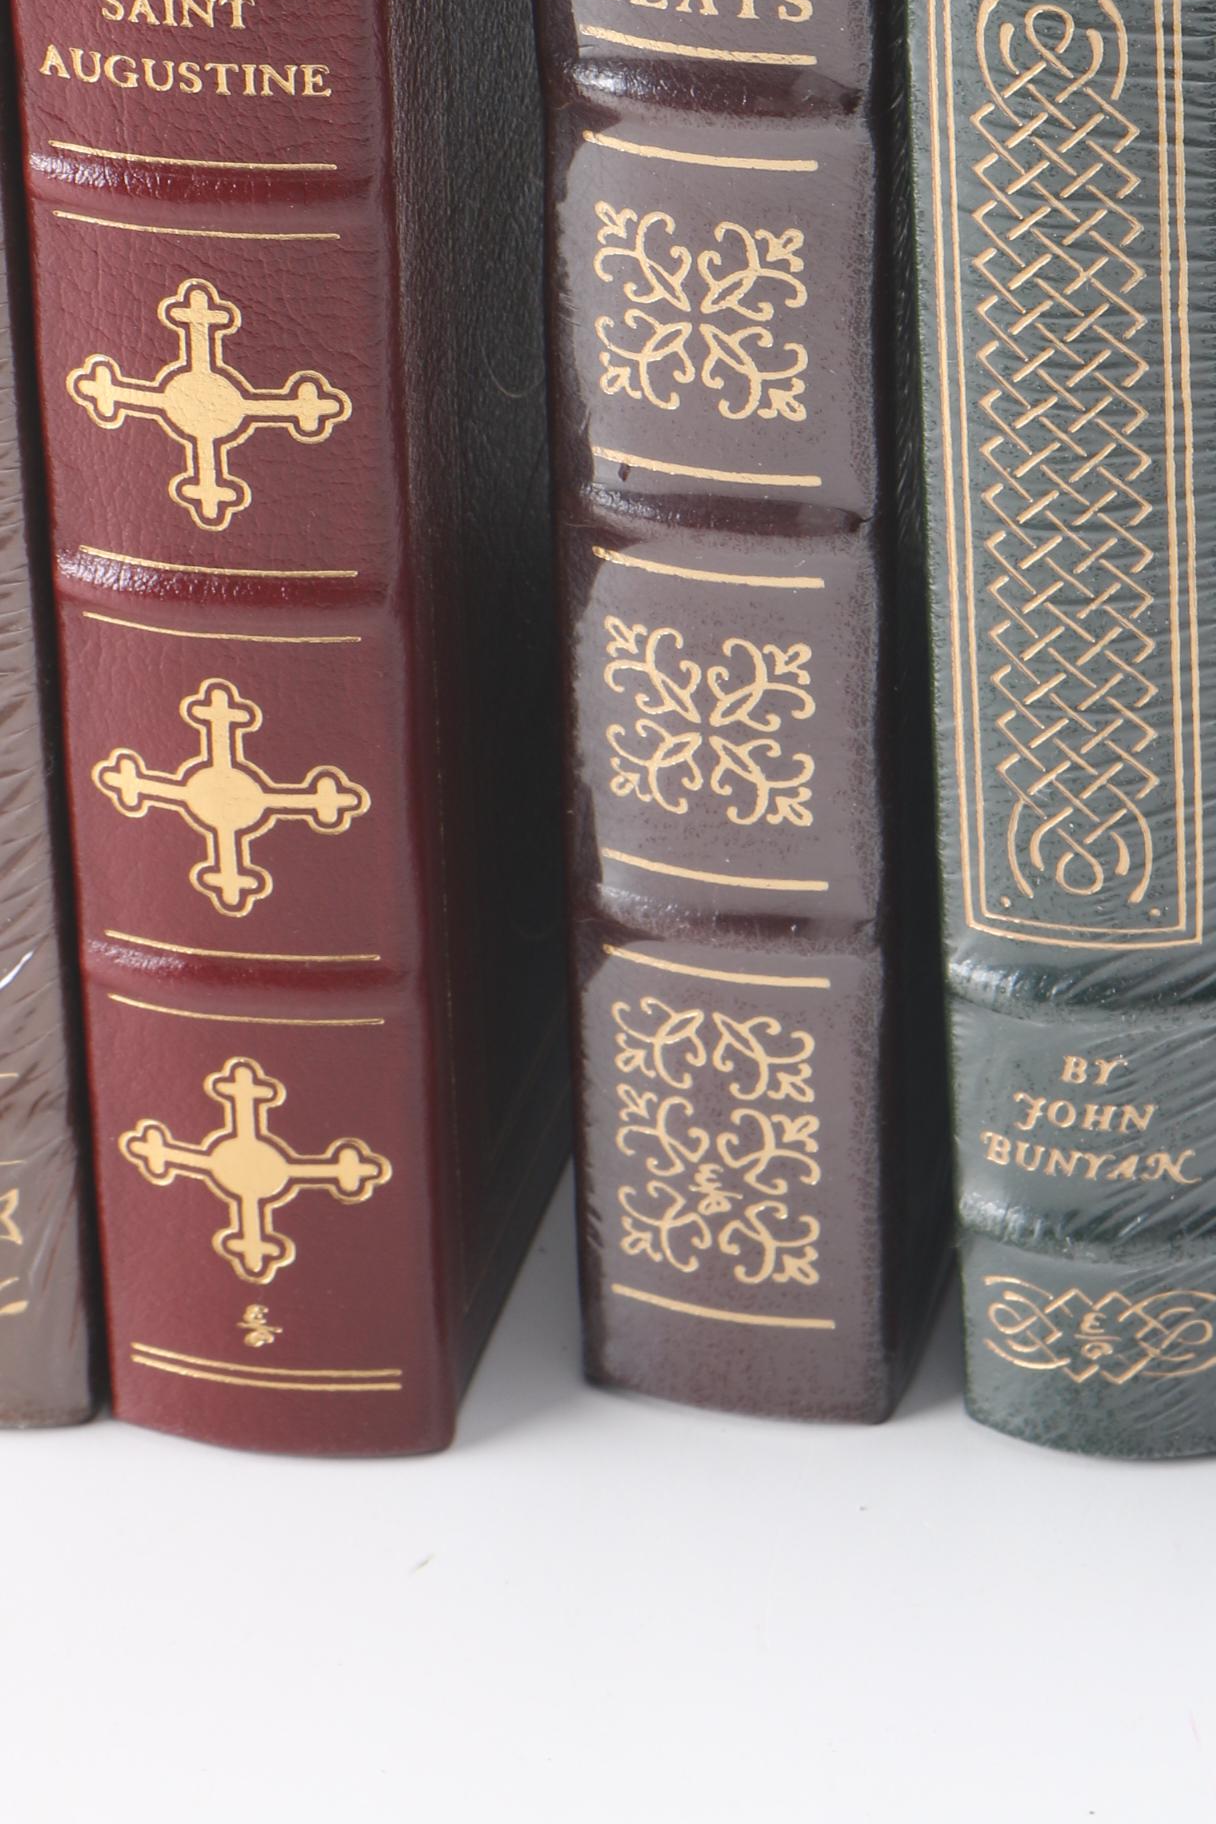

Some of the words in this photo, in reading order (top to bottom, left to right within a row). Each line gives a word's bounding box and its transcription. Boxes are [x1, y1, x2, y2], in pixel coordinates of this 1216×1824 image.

[38, 44, 333, 98] AUGUSTINE
[1059, 1054, 1129, 1087] BY
[1012, 1090, 1159, 1134] JOHN
[979, 1130, 1202, 1185] BUNYAN
